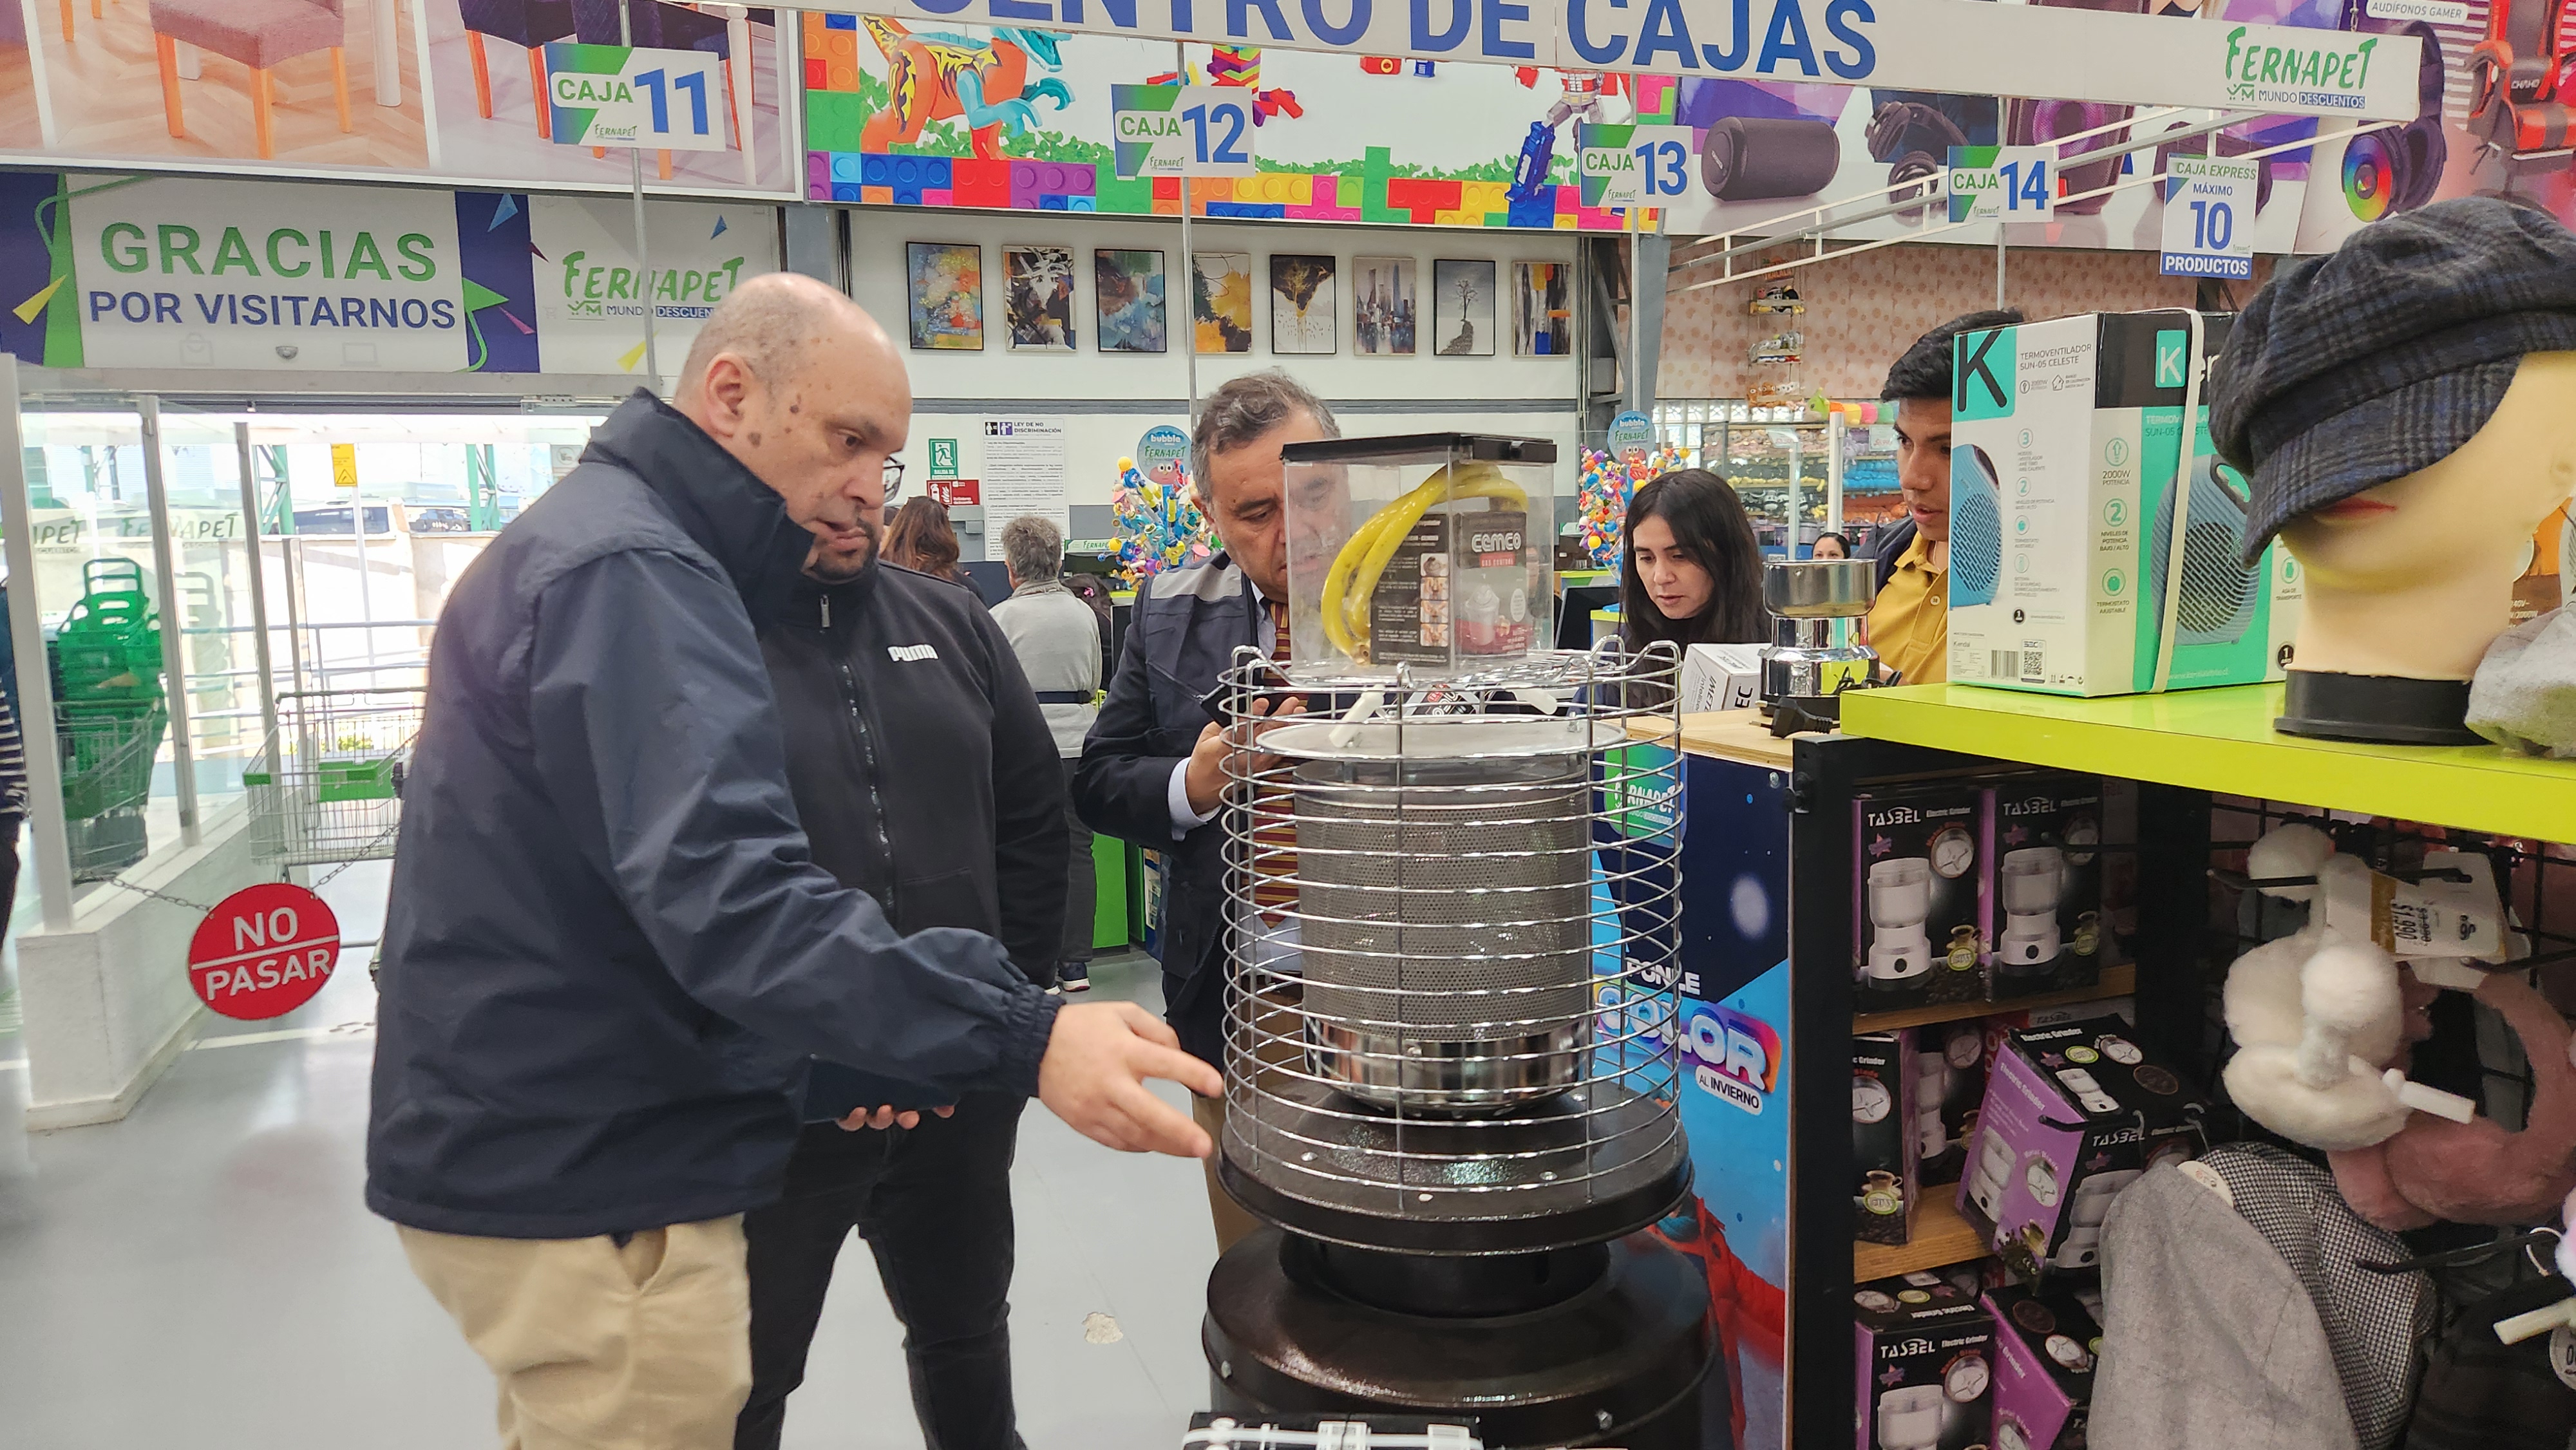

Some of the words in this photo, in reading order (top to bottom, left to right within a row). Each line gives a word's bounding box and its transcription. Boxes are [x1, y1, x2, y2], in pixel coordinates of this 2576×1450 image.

[2371, 2, 2427, 16] AUDÍFONOS
[2429, 8, 2463, 19] GAMER
[1409, 0, 1535, 58] DE
[1566, 0, 1877, 80] CAJAS
[2225, 26, 2378, 90] FERNAPET
[557, 79, 634, 104] CAJA
[634, 68, 710, 135] 11
[2259, 89, 2298, 103] MUNDO
[2300, 93, 2365, 108] DESCUENTOS
[594, 124, 638, 137] FERNAPET
[1120, 117, 1182, 137] CAJA
[1182, 103, 1248, 164] 12
[1586, 153, 1635, 171] CAJA
[1635, 140, 1688, 196] 13
[2176, 162, 2206, 176] CAJA
[2210, 164, 2257, 180] EXPRESS
[1953, 173, 1999, 189] CAJA
[2000, 160, 2049, 211] 14
[2193, 182, 2233, 196] MÁXIMO
[2190, 200, 2233, 250] 10
[100, 221, 437, 282] GRACIAS
[2164, 255, 2249, 276] PRODUCTOS
[89, 290, 183, 324] POR
[194, 292, 456, 330] VISITARNOS
[607, 305, 653, 315] MUND
[2020, 344, 2092, 361] TERMOVENTILADOR
[1957, 327, 2008, 413] K
[2020, 359, 2047, 371] SUN-05
[2048, 355, 2079, 367] CELESTE
[2159, 346, 2182, 384] K
[1150, 434, 1182, 443] bubble
[1615, 428, 1650, 441] FERNAPET
[2022, 431, 2030, 446] 3
[1144, 446, 1186, 458] FERNAPET
[2102, 469, 2131, 479] 2000W
[2020, 480, 2027, 493] 2
[2110, 502, 2122, 522] 2
[1083, 540, 1110, 549] FERNAPE
[887, 644, 939, 662] PUMA
[2003, 796, 2057, 816] TASBEL
[1868, 806, 1921, 827] TASBEL
[232, 907, 299, 951] NO
[205, 948, 332, 1001] PASAR
[1698, 1075, 1709, 1087] AL
[1710, 1077, 1759, 1109] INVIERNO
[1880, 1337, 1936, 1359] TASBEL
